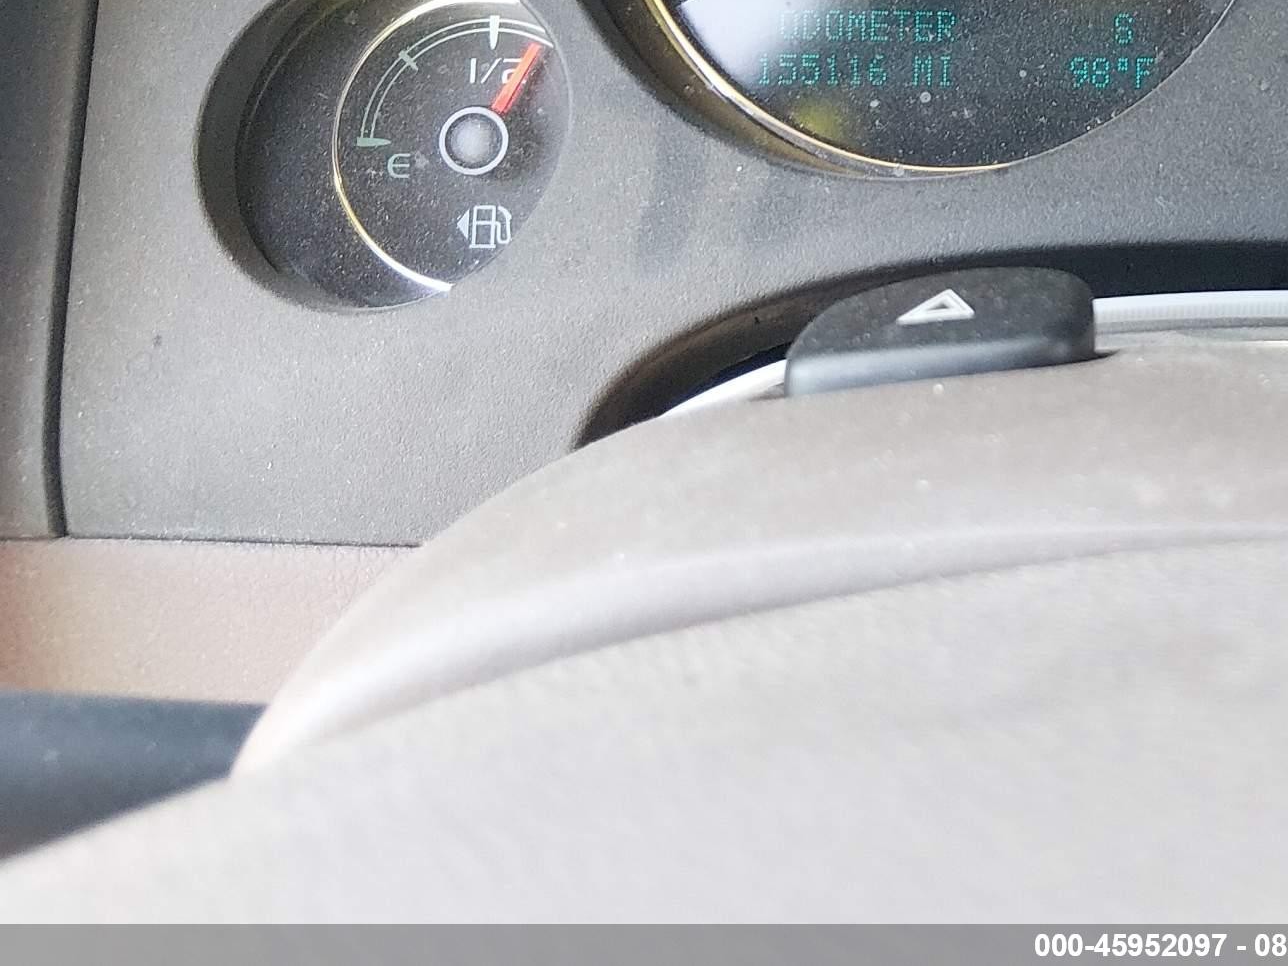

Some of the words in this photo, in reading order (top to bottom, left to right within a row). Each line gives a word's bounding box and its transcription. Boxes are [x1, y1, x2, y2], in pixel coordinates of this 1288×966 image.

[780, 9, 957, 42] ODOMETER
[759, 52, 887, 86] 155116
[912, 55, 951, 86] MI
